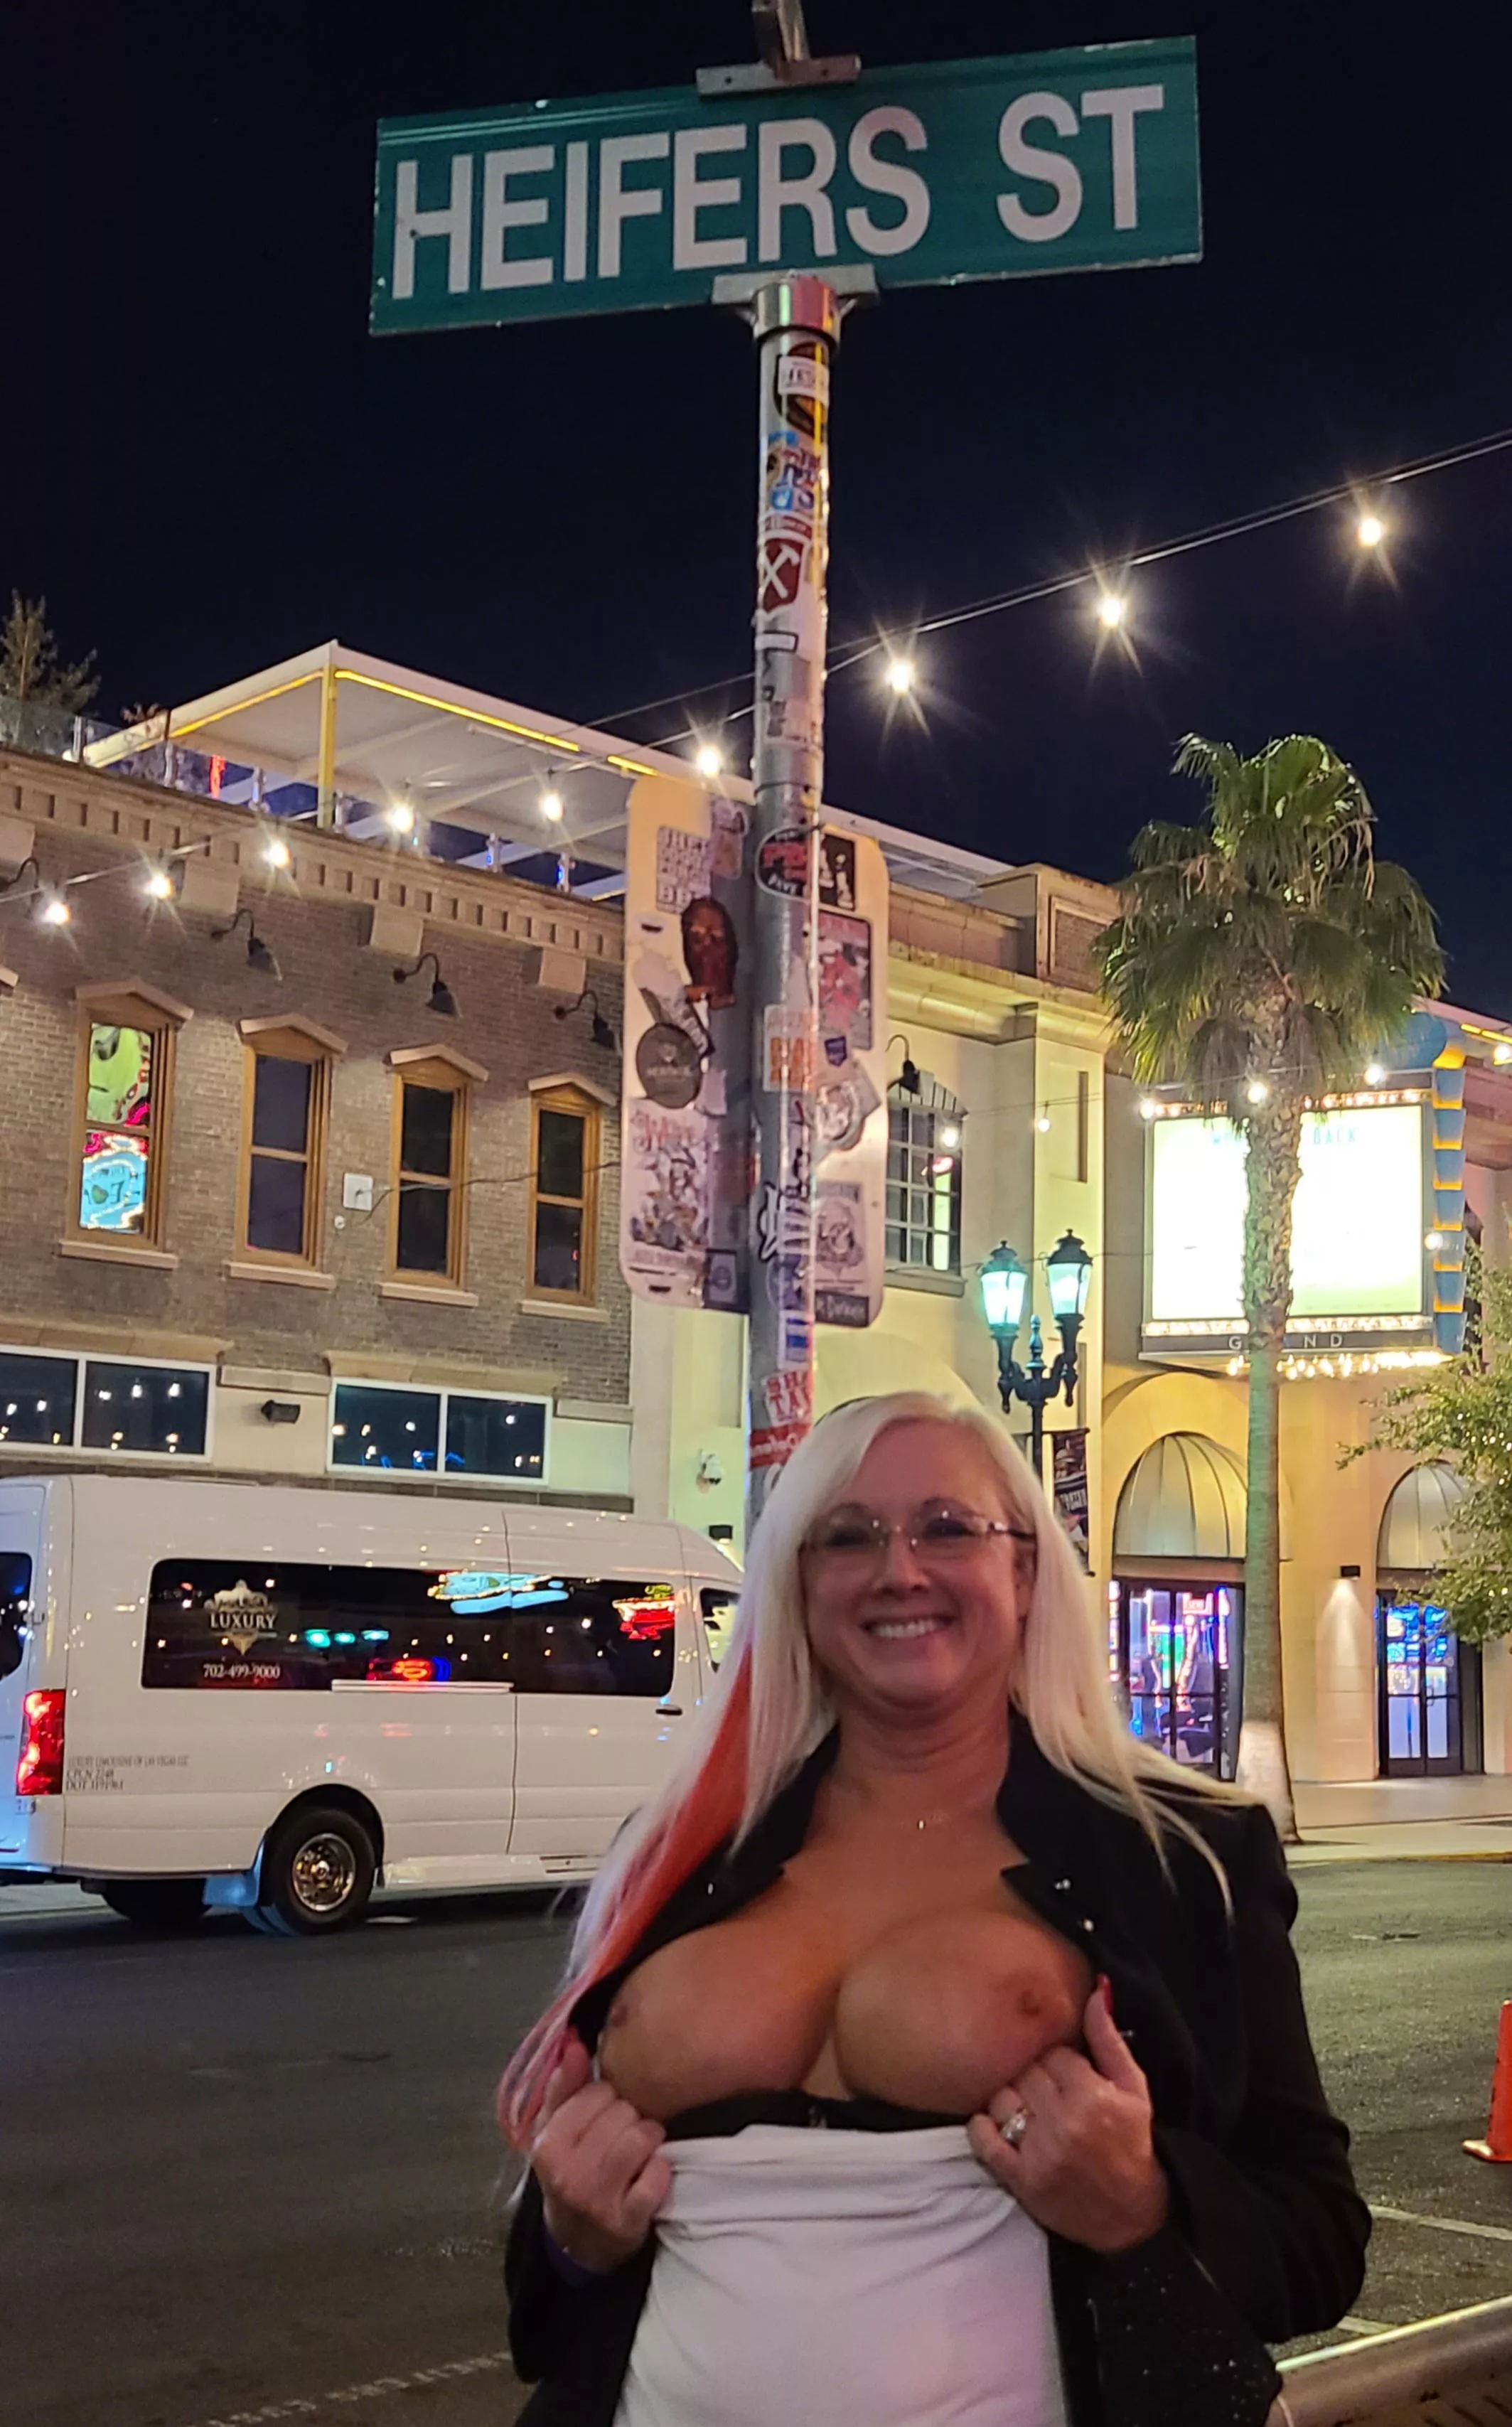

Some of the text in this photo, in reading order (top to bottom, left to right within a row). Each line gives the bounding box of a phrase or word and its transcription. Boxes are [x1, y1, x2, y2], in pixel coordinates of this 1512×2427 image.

[392, 84, 1164, 299] HEIFERS ST
[1228, 1334, 1342, 1349] GND
[210, 1612, 277, 1629] LUXURY
